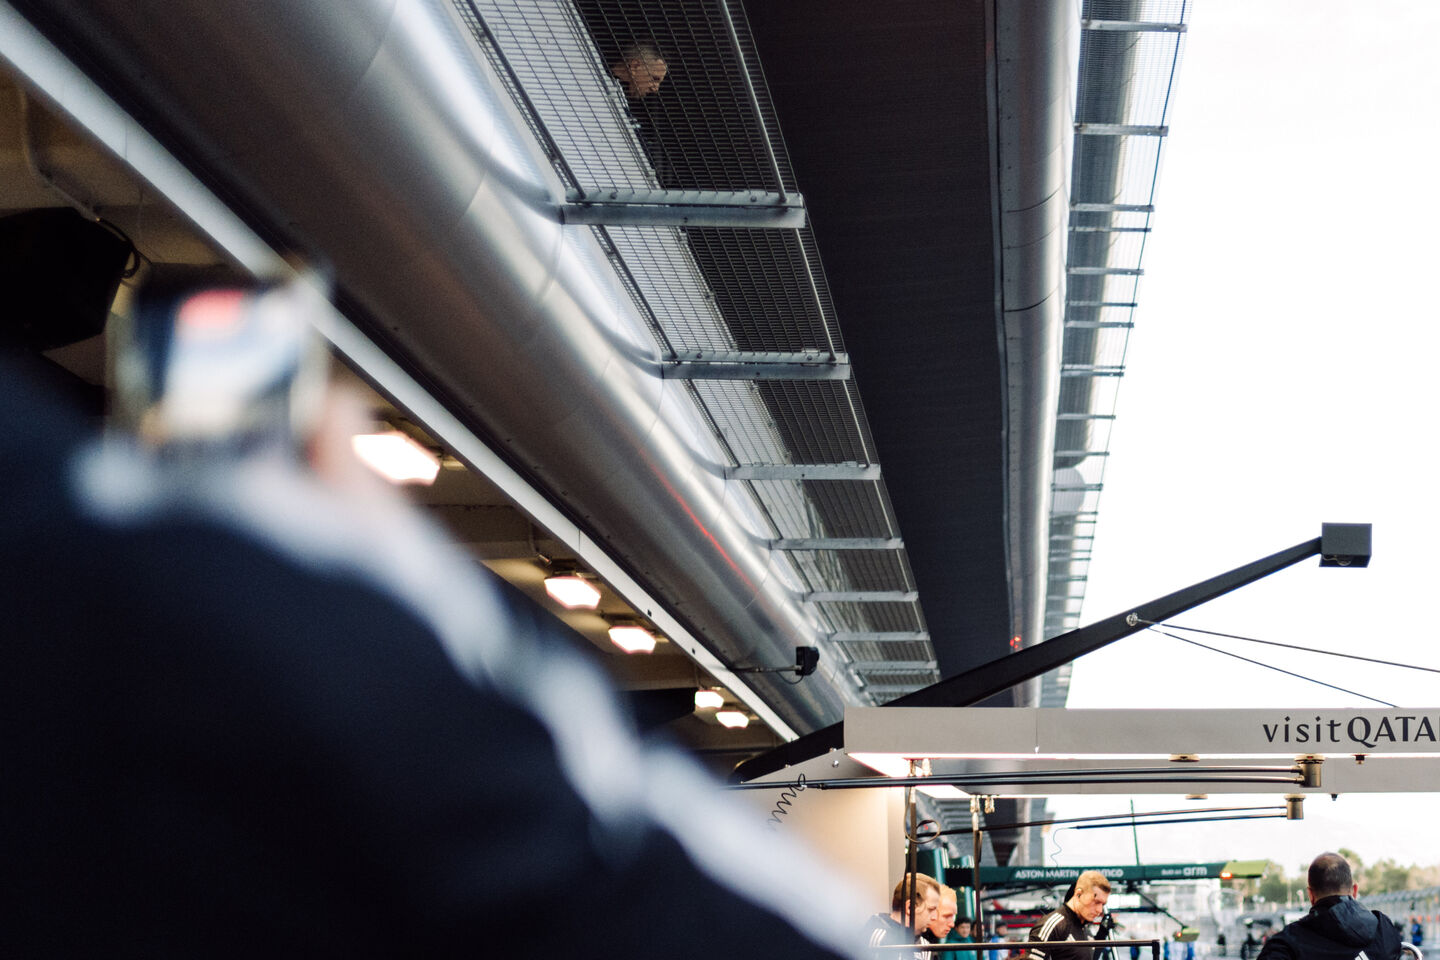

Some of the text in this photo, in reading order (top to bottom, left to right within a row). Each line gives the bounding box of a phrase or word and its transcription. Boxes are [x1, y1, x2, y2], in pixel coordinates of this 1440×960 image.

[1015, 869, 1044, 879] ASTON
[1046, 869, 1079, 878] MARTIN
[1183, 866, 1208, 877] arm
